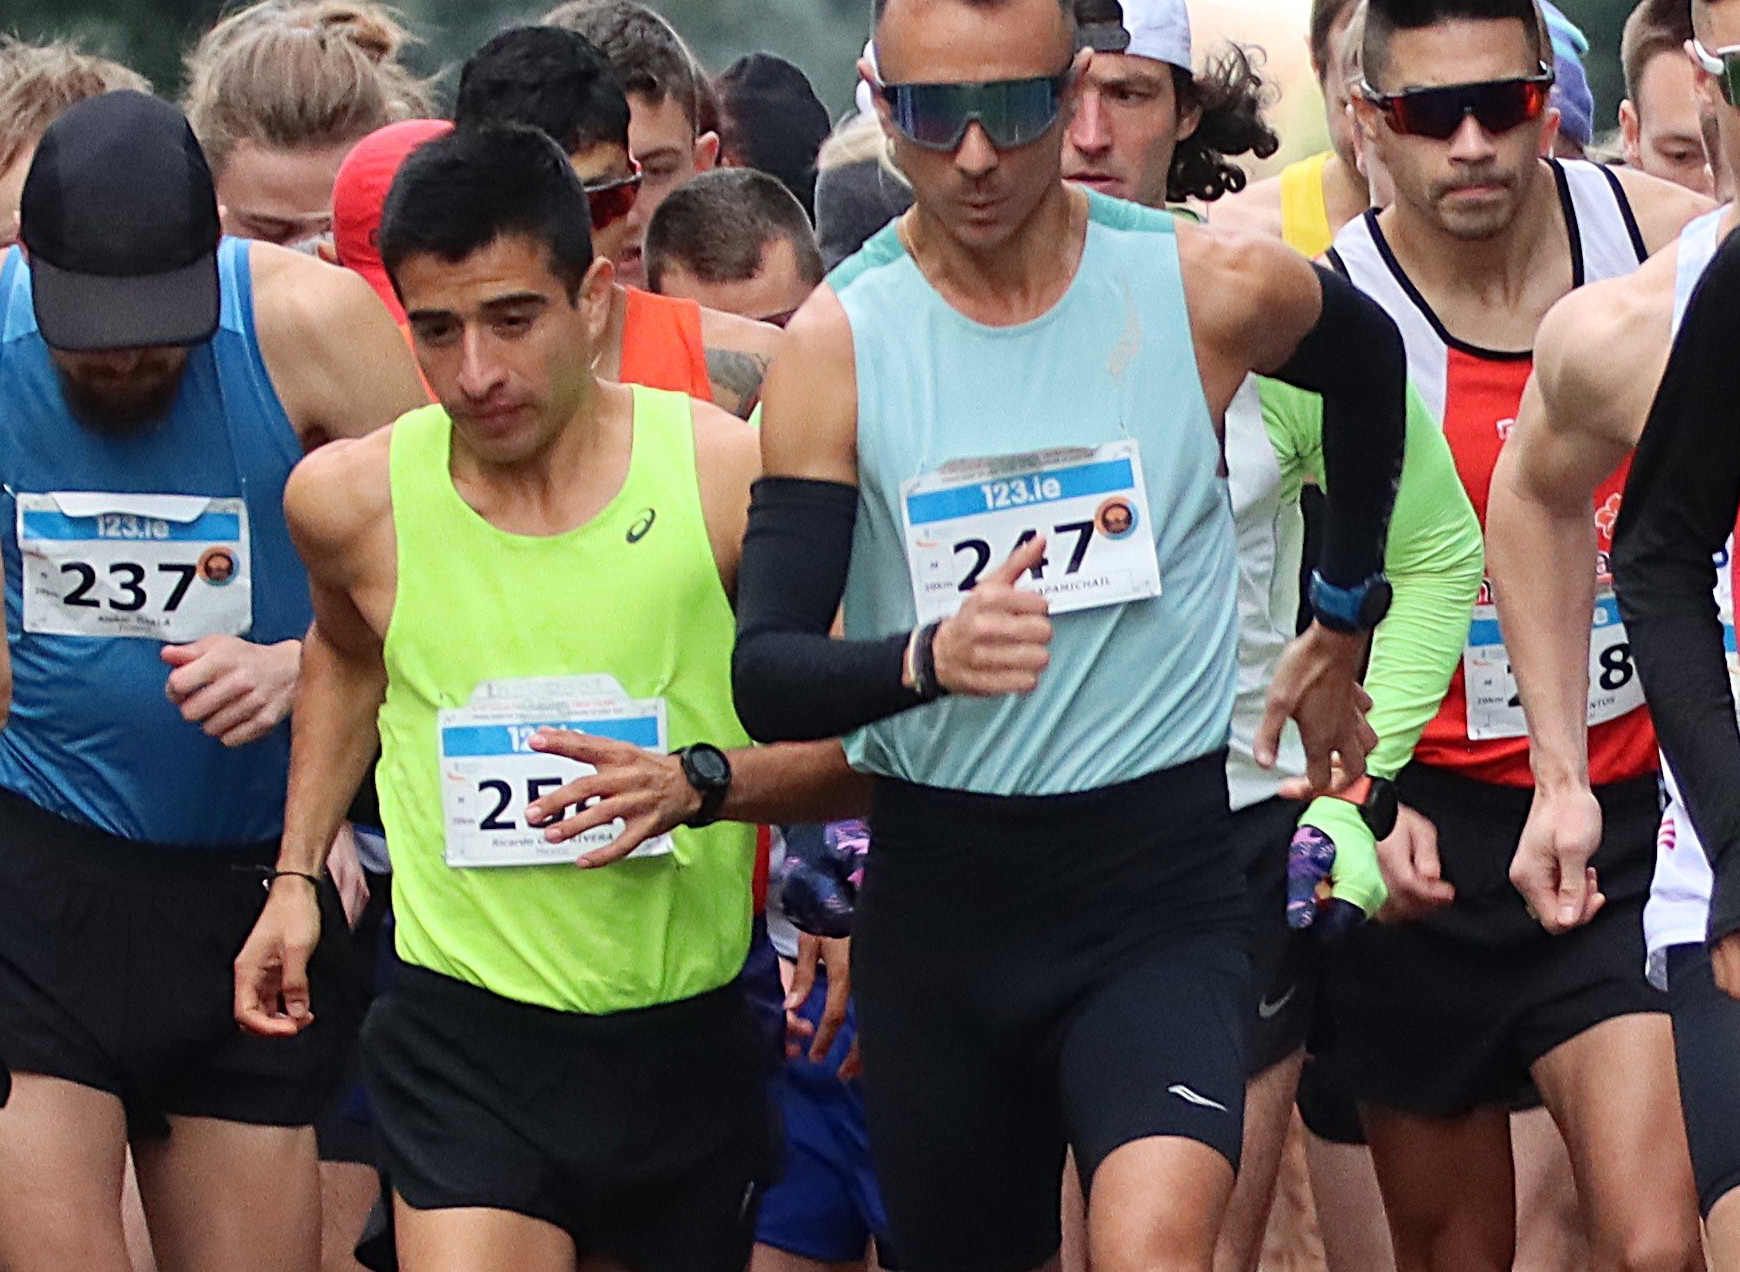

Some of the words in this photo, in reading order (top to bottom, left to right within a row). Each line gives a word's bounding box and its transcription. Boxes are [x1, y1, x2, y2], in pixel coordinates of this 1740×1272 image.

[980, 476, 1062, 510] 123.ie
[60, 561, 197, 612] 237
[477, 777, 605, 831] 25
